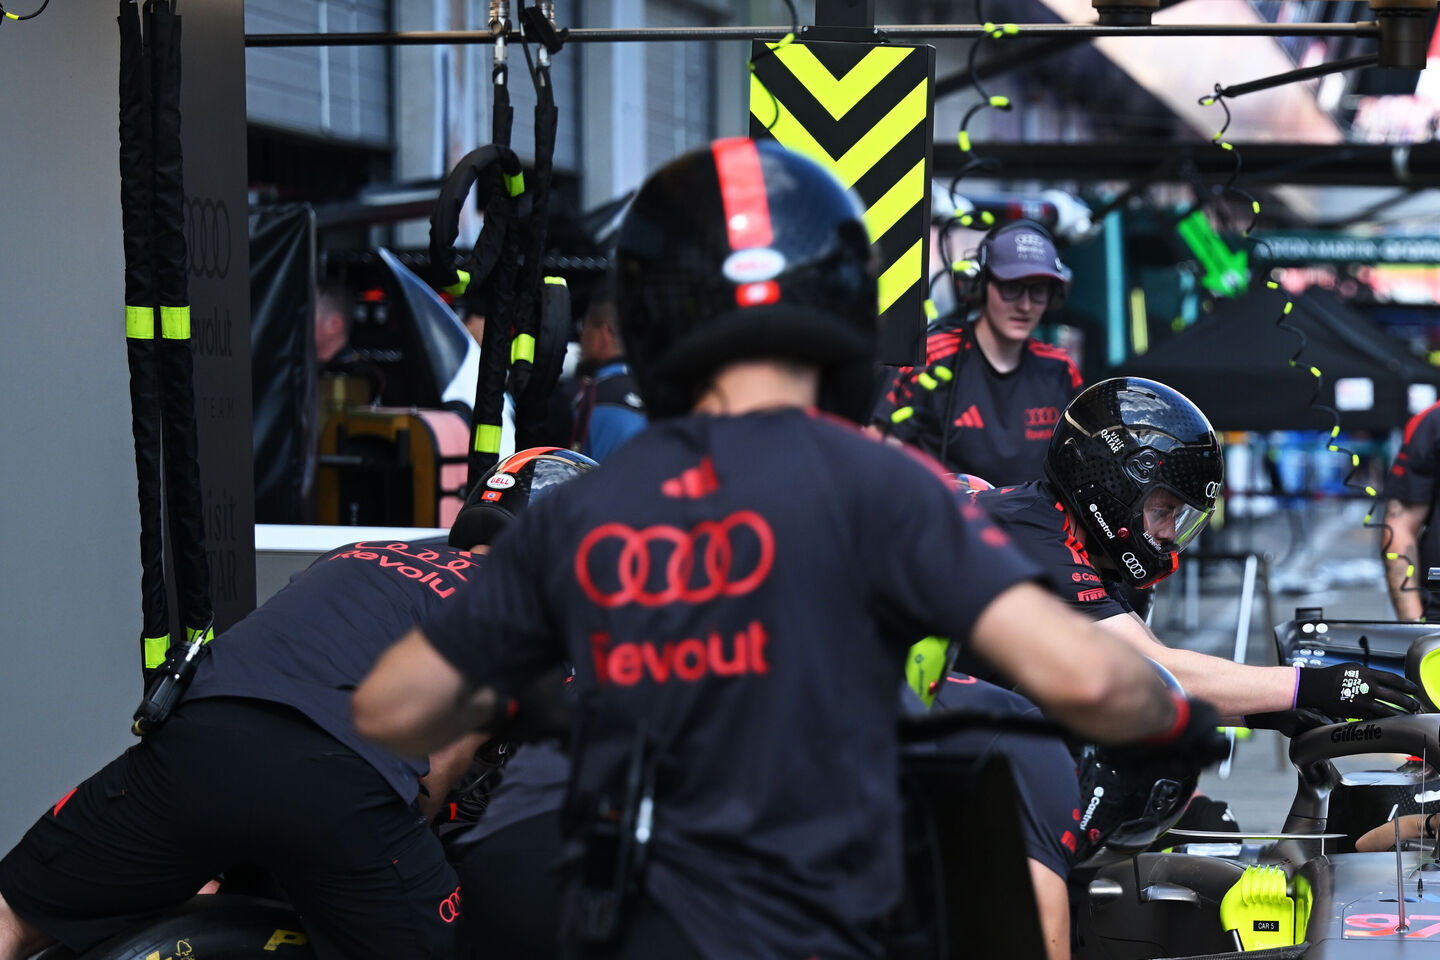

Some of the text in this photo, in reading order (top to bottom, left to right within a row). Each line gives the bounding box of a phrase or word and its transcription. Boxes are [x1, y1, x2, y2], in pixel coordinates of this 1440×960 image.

[191, 306, 232, 357] evolut
[1100, 429, 1120, 453] QATAR
[1093, 510, 1116, 540] Castrol
[1330, 724, 1382, 743] Gillette
